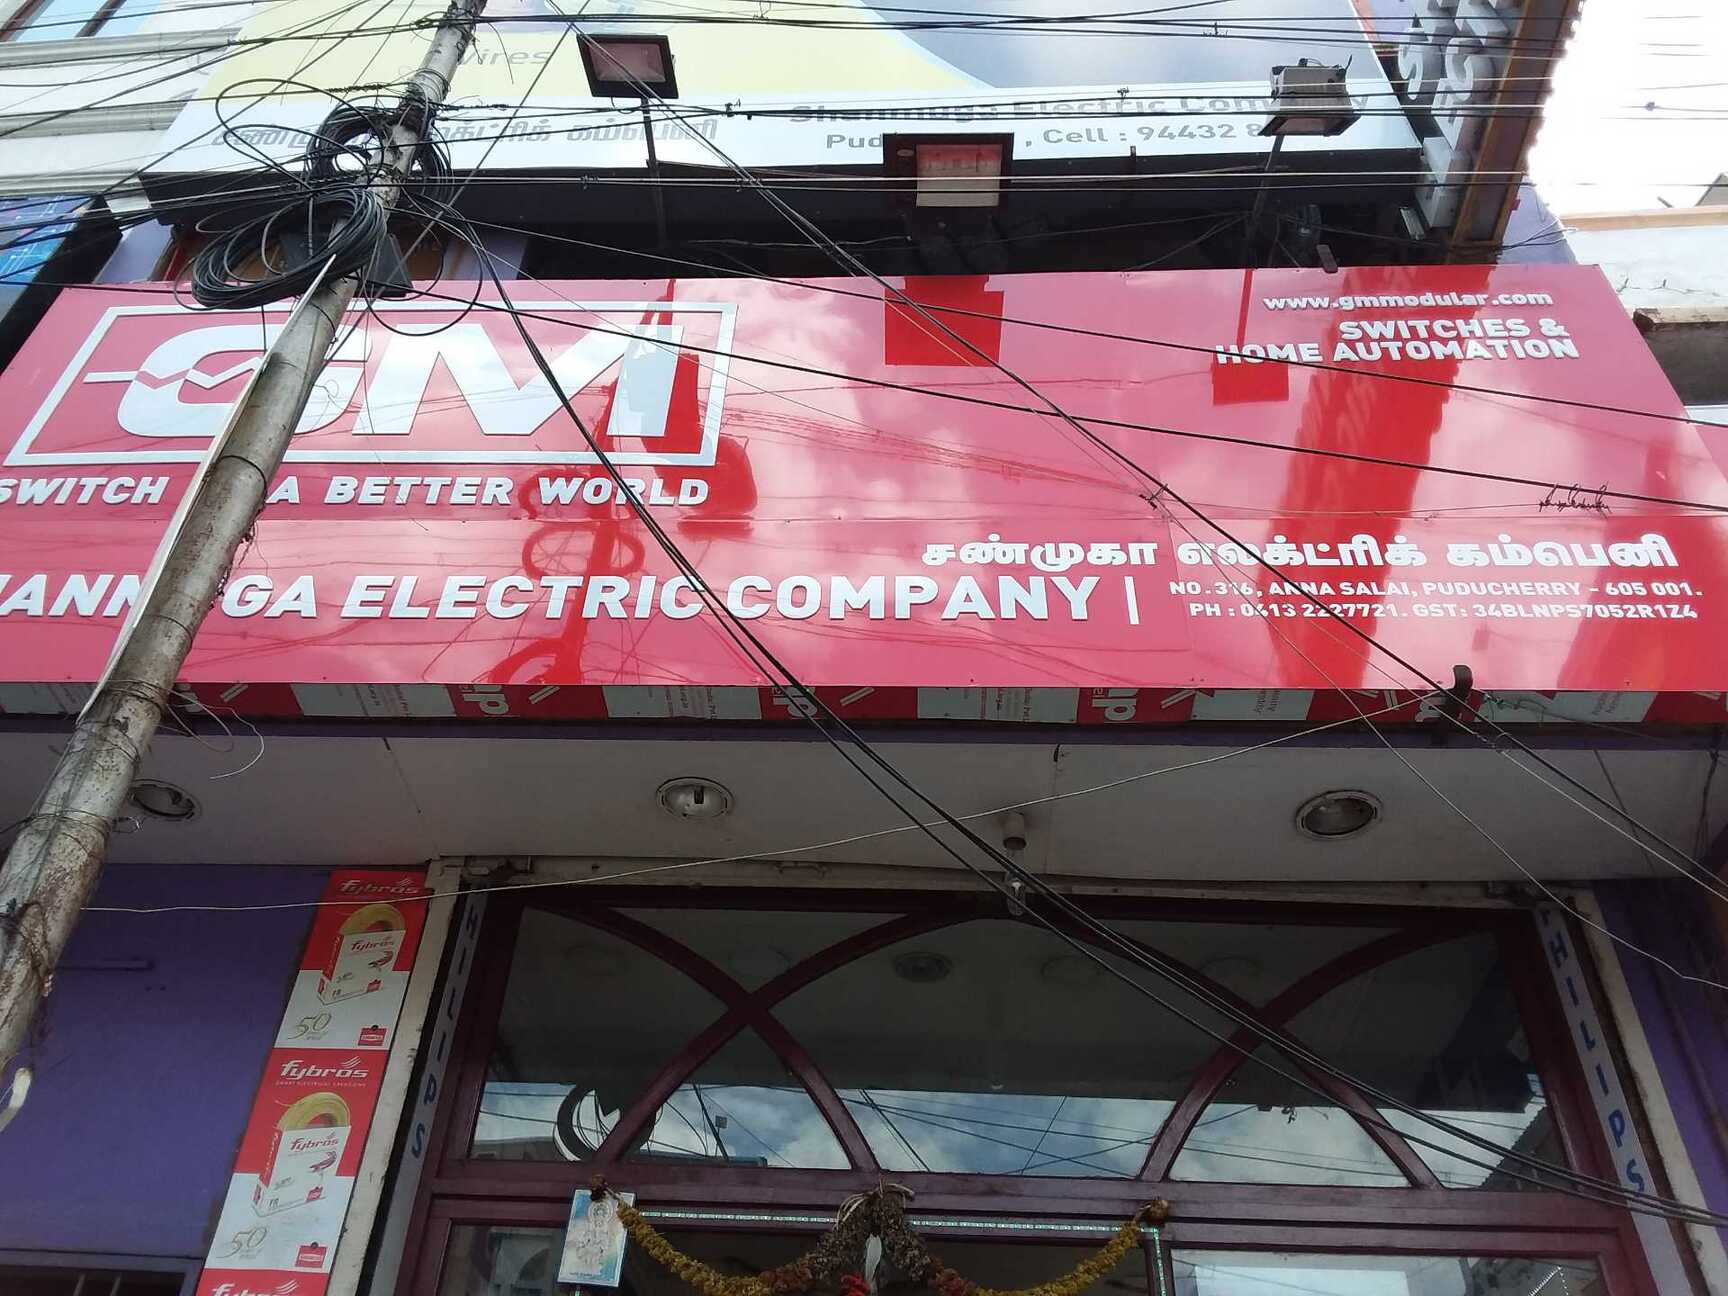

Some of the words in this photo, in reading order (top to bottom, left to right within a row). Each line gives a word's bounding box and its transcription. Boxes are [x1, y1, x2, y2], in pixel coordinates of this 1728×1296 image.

[1043, 128, 1108, 144] Cell
[1137, 123, 1237, 141] 94432
[1262, 290, 1554, 311] www.gmmodular.com
[1338, 318, 1531, 341] SWITCHES
[1538, 317, 1571, 338] &
[1214, 342, 1332, 366] HOME
[1332, 338, 1581, 363] AUTOMATION
[325, 475, 514, 505] BETTER
[538, 476, 710, 506] WORLD
[921, 533, 1158, 572] சண்முகா
[1177, 533, 1428, 567] எலக்ட்ரிக்
[1445, 533, 1681, 568] கம்பெனி
[340, 574, 706, 620] ELECTRIC
[727, 574, 1101, 622] COMPANY
[1268, 581, 1337, 596] ANNA
[1423, 581, 1581, 596] PUDUCHERRY
[1605, 582, 1648, 596] 605
[280, 1059, 369, 1080] fybros
